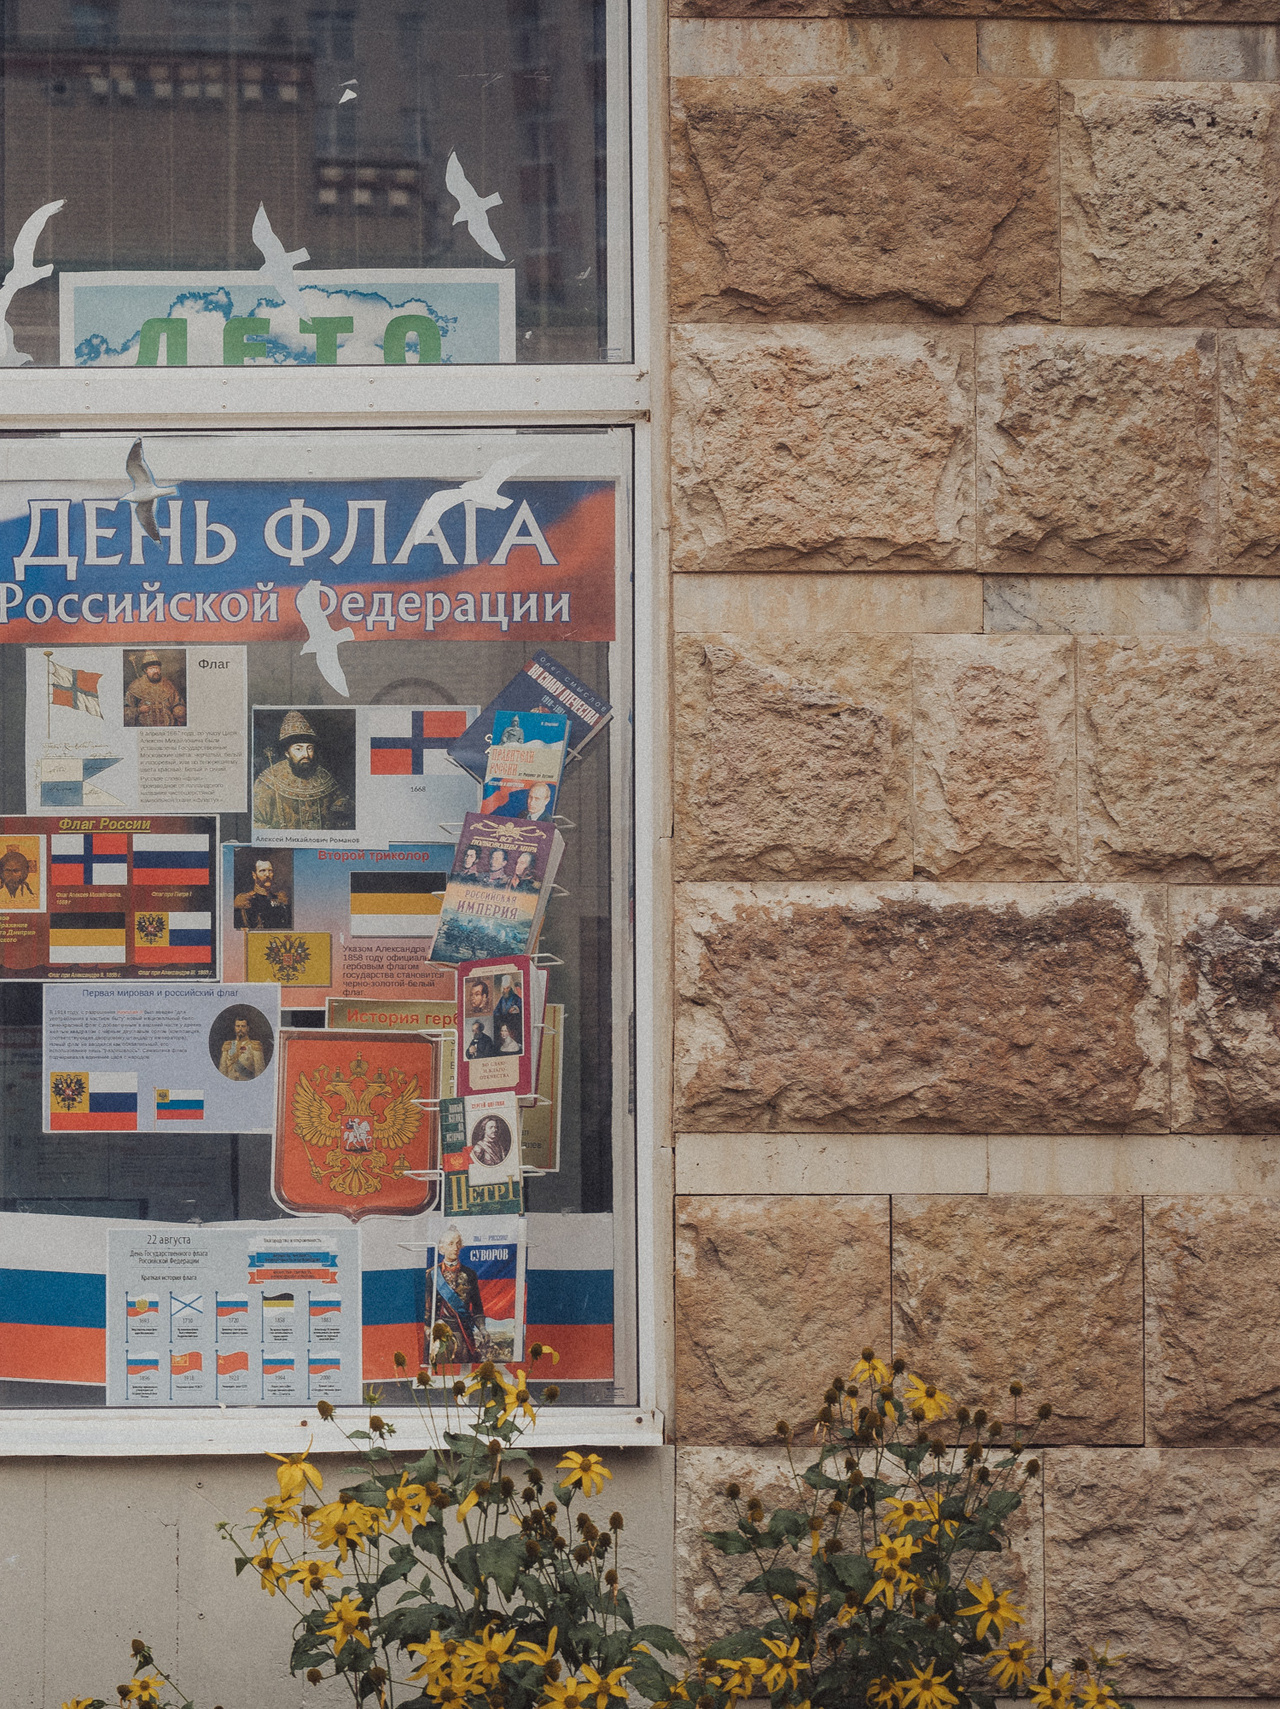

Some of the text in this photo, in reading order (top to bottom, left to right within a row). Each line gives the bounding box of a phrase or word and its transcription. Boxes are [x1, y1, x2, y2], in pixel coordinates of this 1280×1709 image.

[13, 498, 559, 581] ДЕНЬ ФЛАГА
[198, 659, 230, 670] Флаг
[537, 672, 566, 695] СЛАВУ
[559, 690, 599, 725] ОТЕЧЕСТВА
[490, 763, 517, 776] РОССИИ
[59, 818, 151, 831] Флаг России
[318, 851, 429, 863] Второй триколор
[465, 890, 517, 904] РОССИЙСКАЯ
[456, 900, 518, 920] ИМПЕРИЯ
[375, 945, 425, 954] Александра
[366, 955, 383, 963] году
[387, 963, 419, 971] флагом
[343, 972, 393, 980] государства
[343, 980, 435, 988] черно-золотой-белый
[82, 989, 114, 997] Первая
[117, 990, 154, 998] мировая
[165, 988, 214, 998] российский
[347, 1009, 419, 1026] История
[449, 1174, 506, 1211] ПЕТР
[147, 1235, 191, 1246] 22 августа
[470, 1249, 509, 1261] СУВОРОВ
